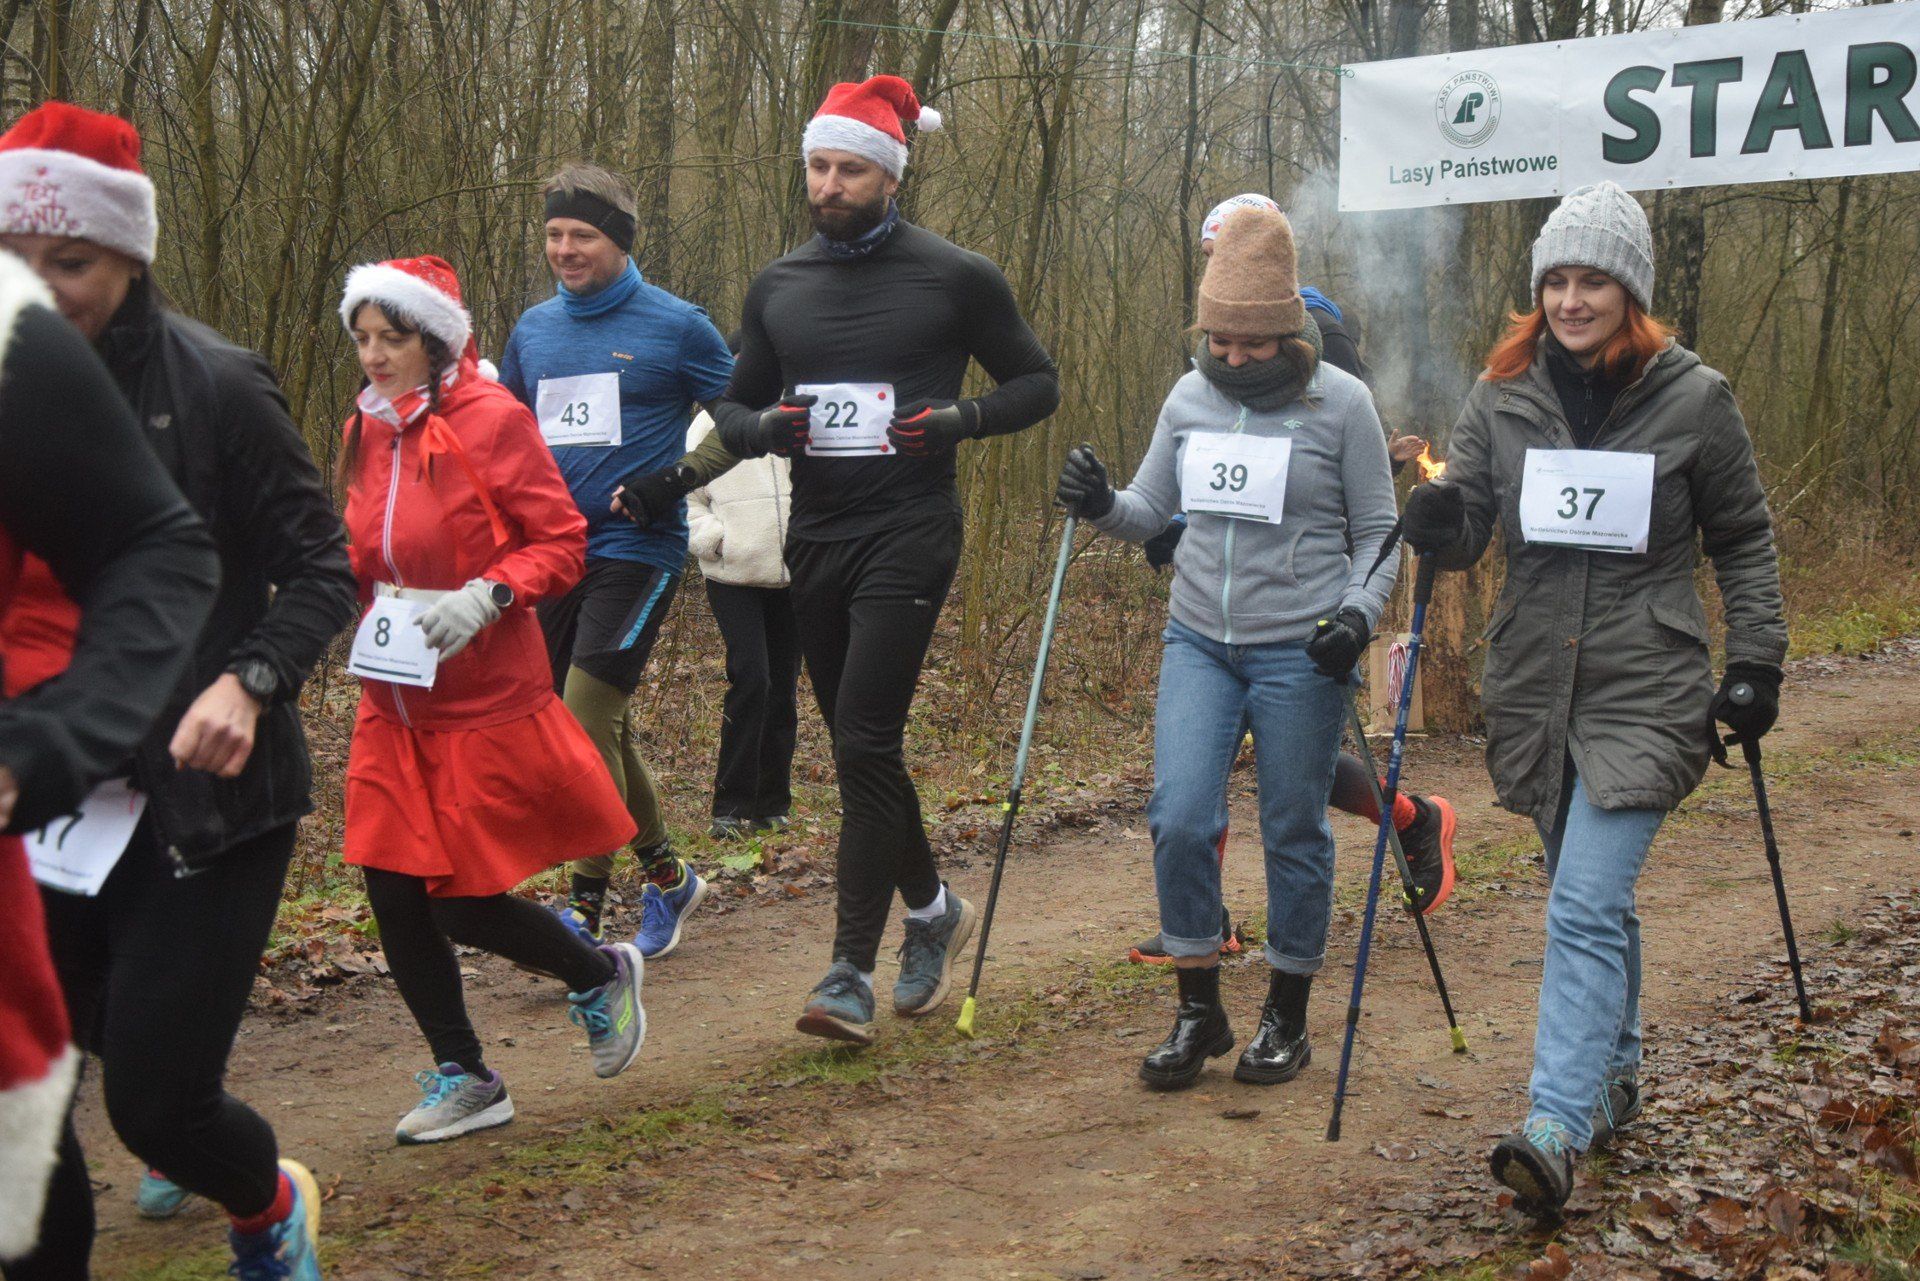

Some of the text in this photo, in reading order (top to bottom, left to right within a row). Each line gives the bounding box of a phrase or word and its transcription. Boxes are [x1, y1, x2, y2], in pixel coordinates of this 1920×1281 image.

[1438, 83, 1452, 109] LASY
[1453, 73, 1499, 104] PAŃSTWOWE
[1601, 41, 1920, 165] STAR
[1389, 155, 1558, 186] Lasy Państwowe
[560, 402, 589, 426] 43
[824, 401, 858, 428] 22
[1209, 462, 1248, 492] 39
[1557, 487, 1606, 521] 37
[375, 617, 391, 648] 8
